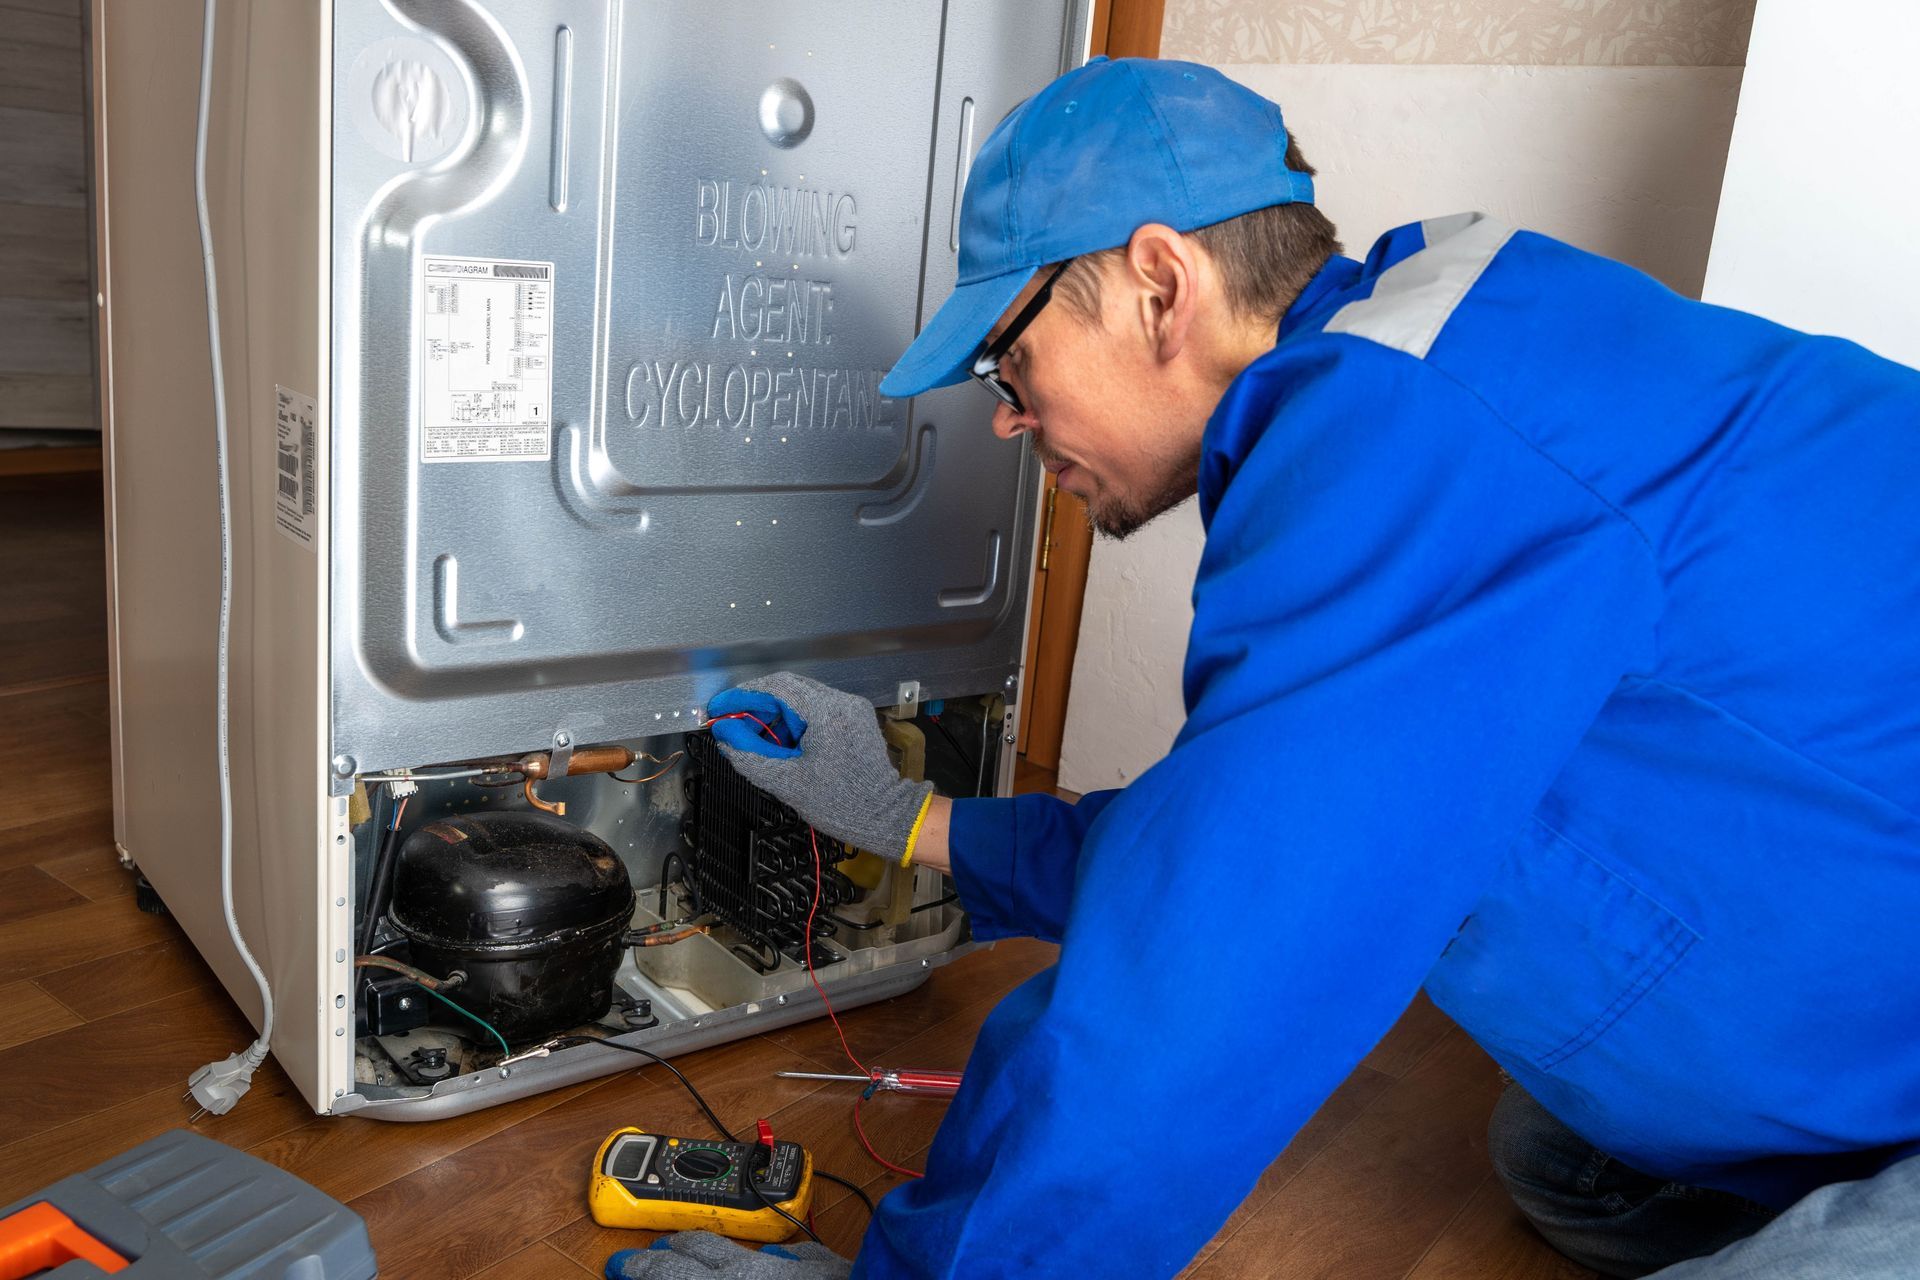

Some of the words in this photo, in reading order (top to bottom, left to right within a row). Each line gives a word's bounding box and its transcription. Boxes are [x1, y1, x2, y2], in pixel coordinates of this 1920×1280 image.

[696, 178, 857, 260] BLOWING
[533, 406, 539, 416] 1
[623, 360, 893, 430] CYCLOPENTANE
